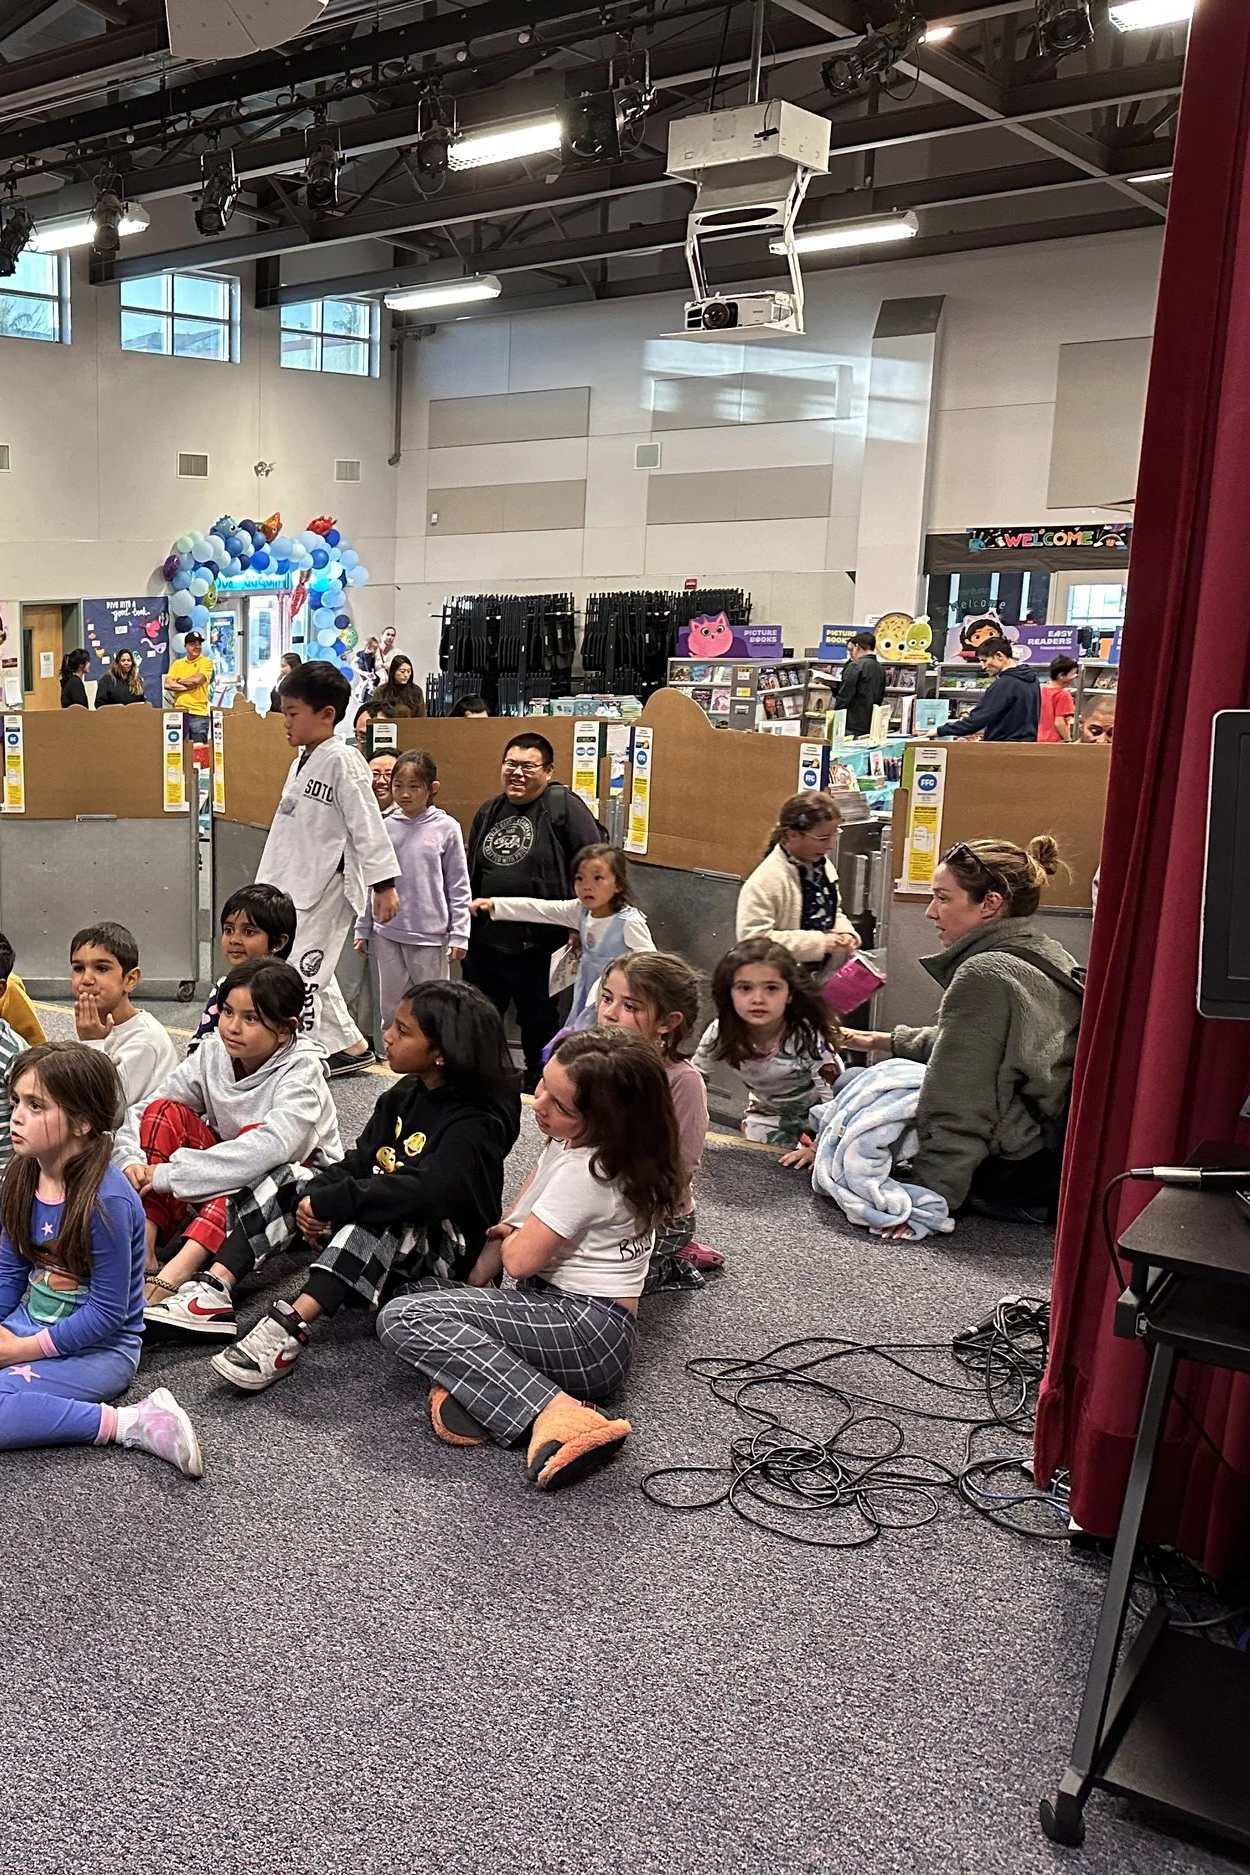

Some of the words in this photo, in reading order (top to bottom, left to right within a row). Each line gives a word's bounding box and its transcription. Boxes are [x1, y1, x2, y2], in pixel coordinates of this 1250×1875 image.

[1004, 530, 1094, 547] WELCOME
[1027, 637, 1073, 645] READERS
[920, 778, 935, 787] FFC
